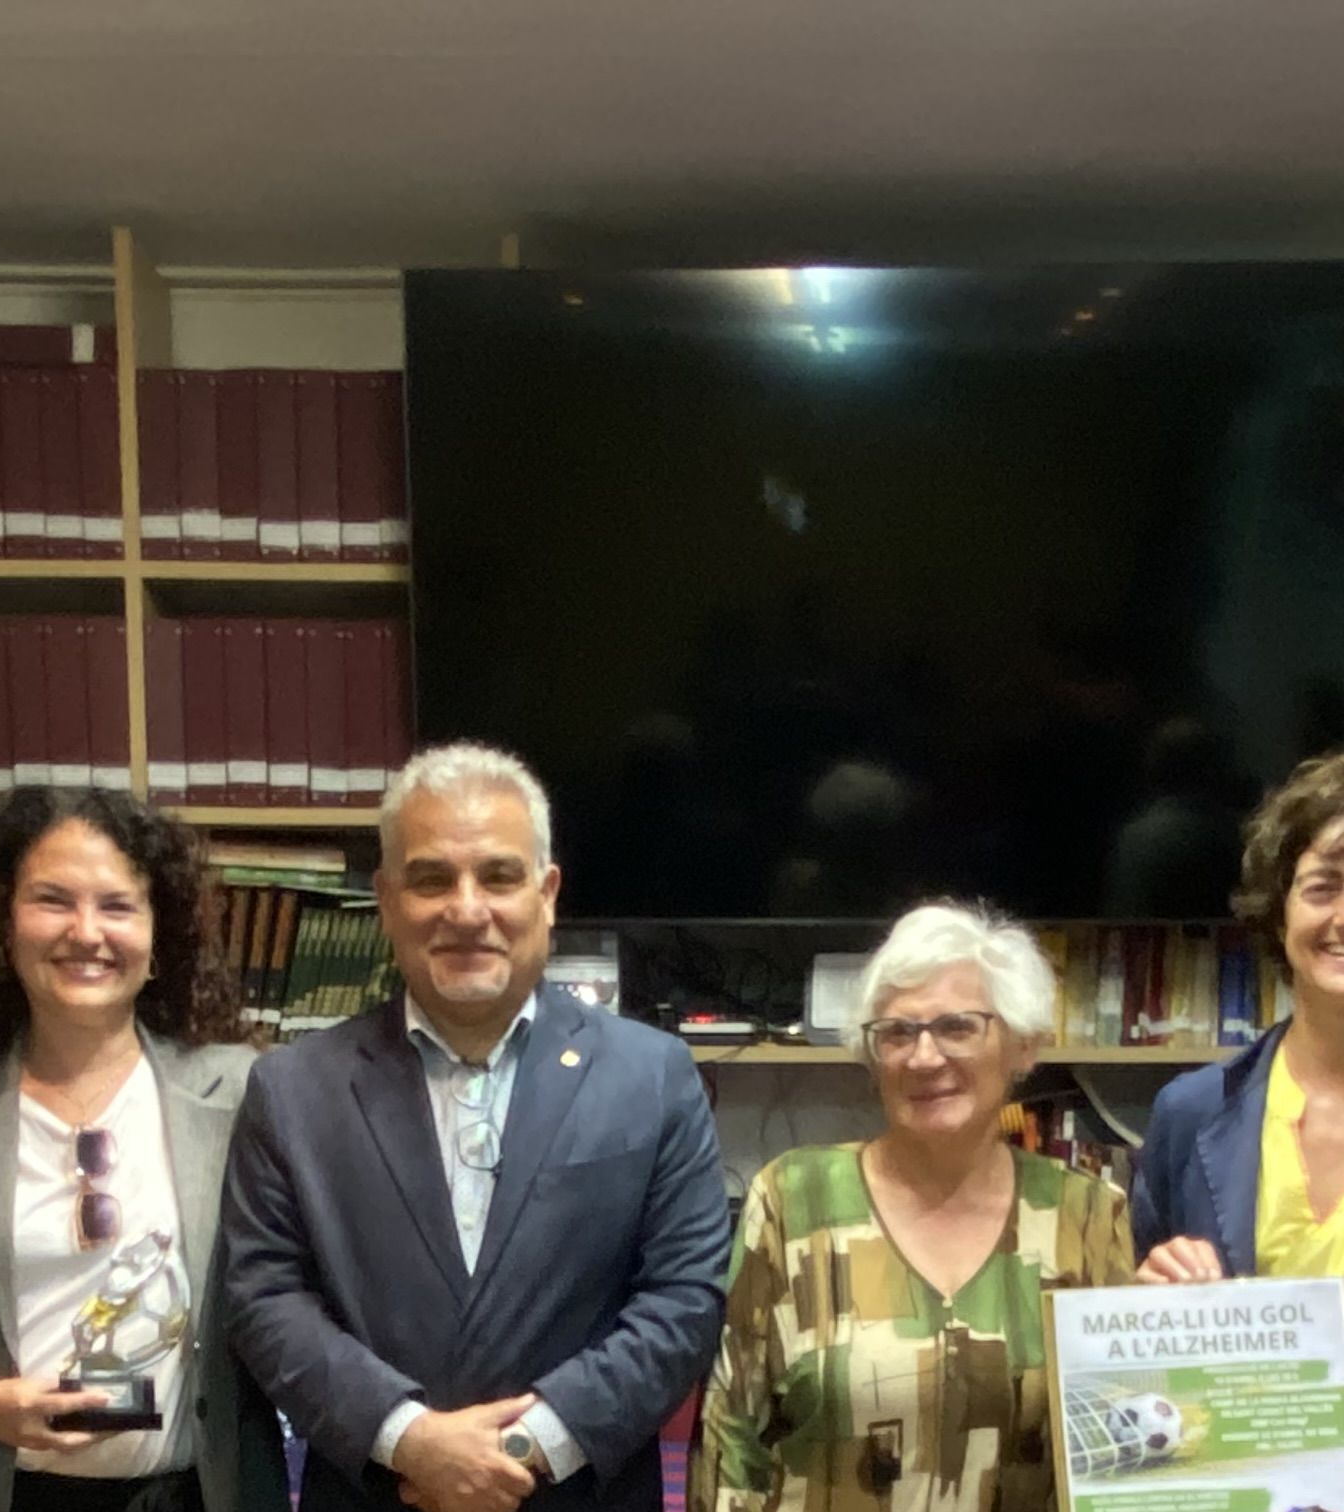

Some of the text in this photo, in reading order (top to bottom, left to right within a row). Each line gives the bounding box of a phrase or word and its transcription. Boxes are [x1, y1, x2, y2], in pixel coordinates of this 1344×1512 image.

[1082, 1303, 1314, 1335] MARCA-LI UN GOL
[1108, 1330, 1299, 1360] A L'ALZHEIMER
